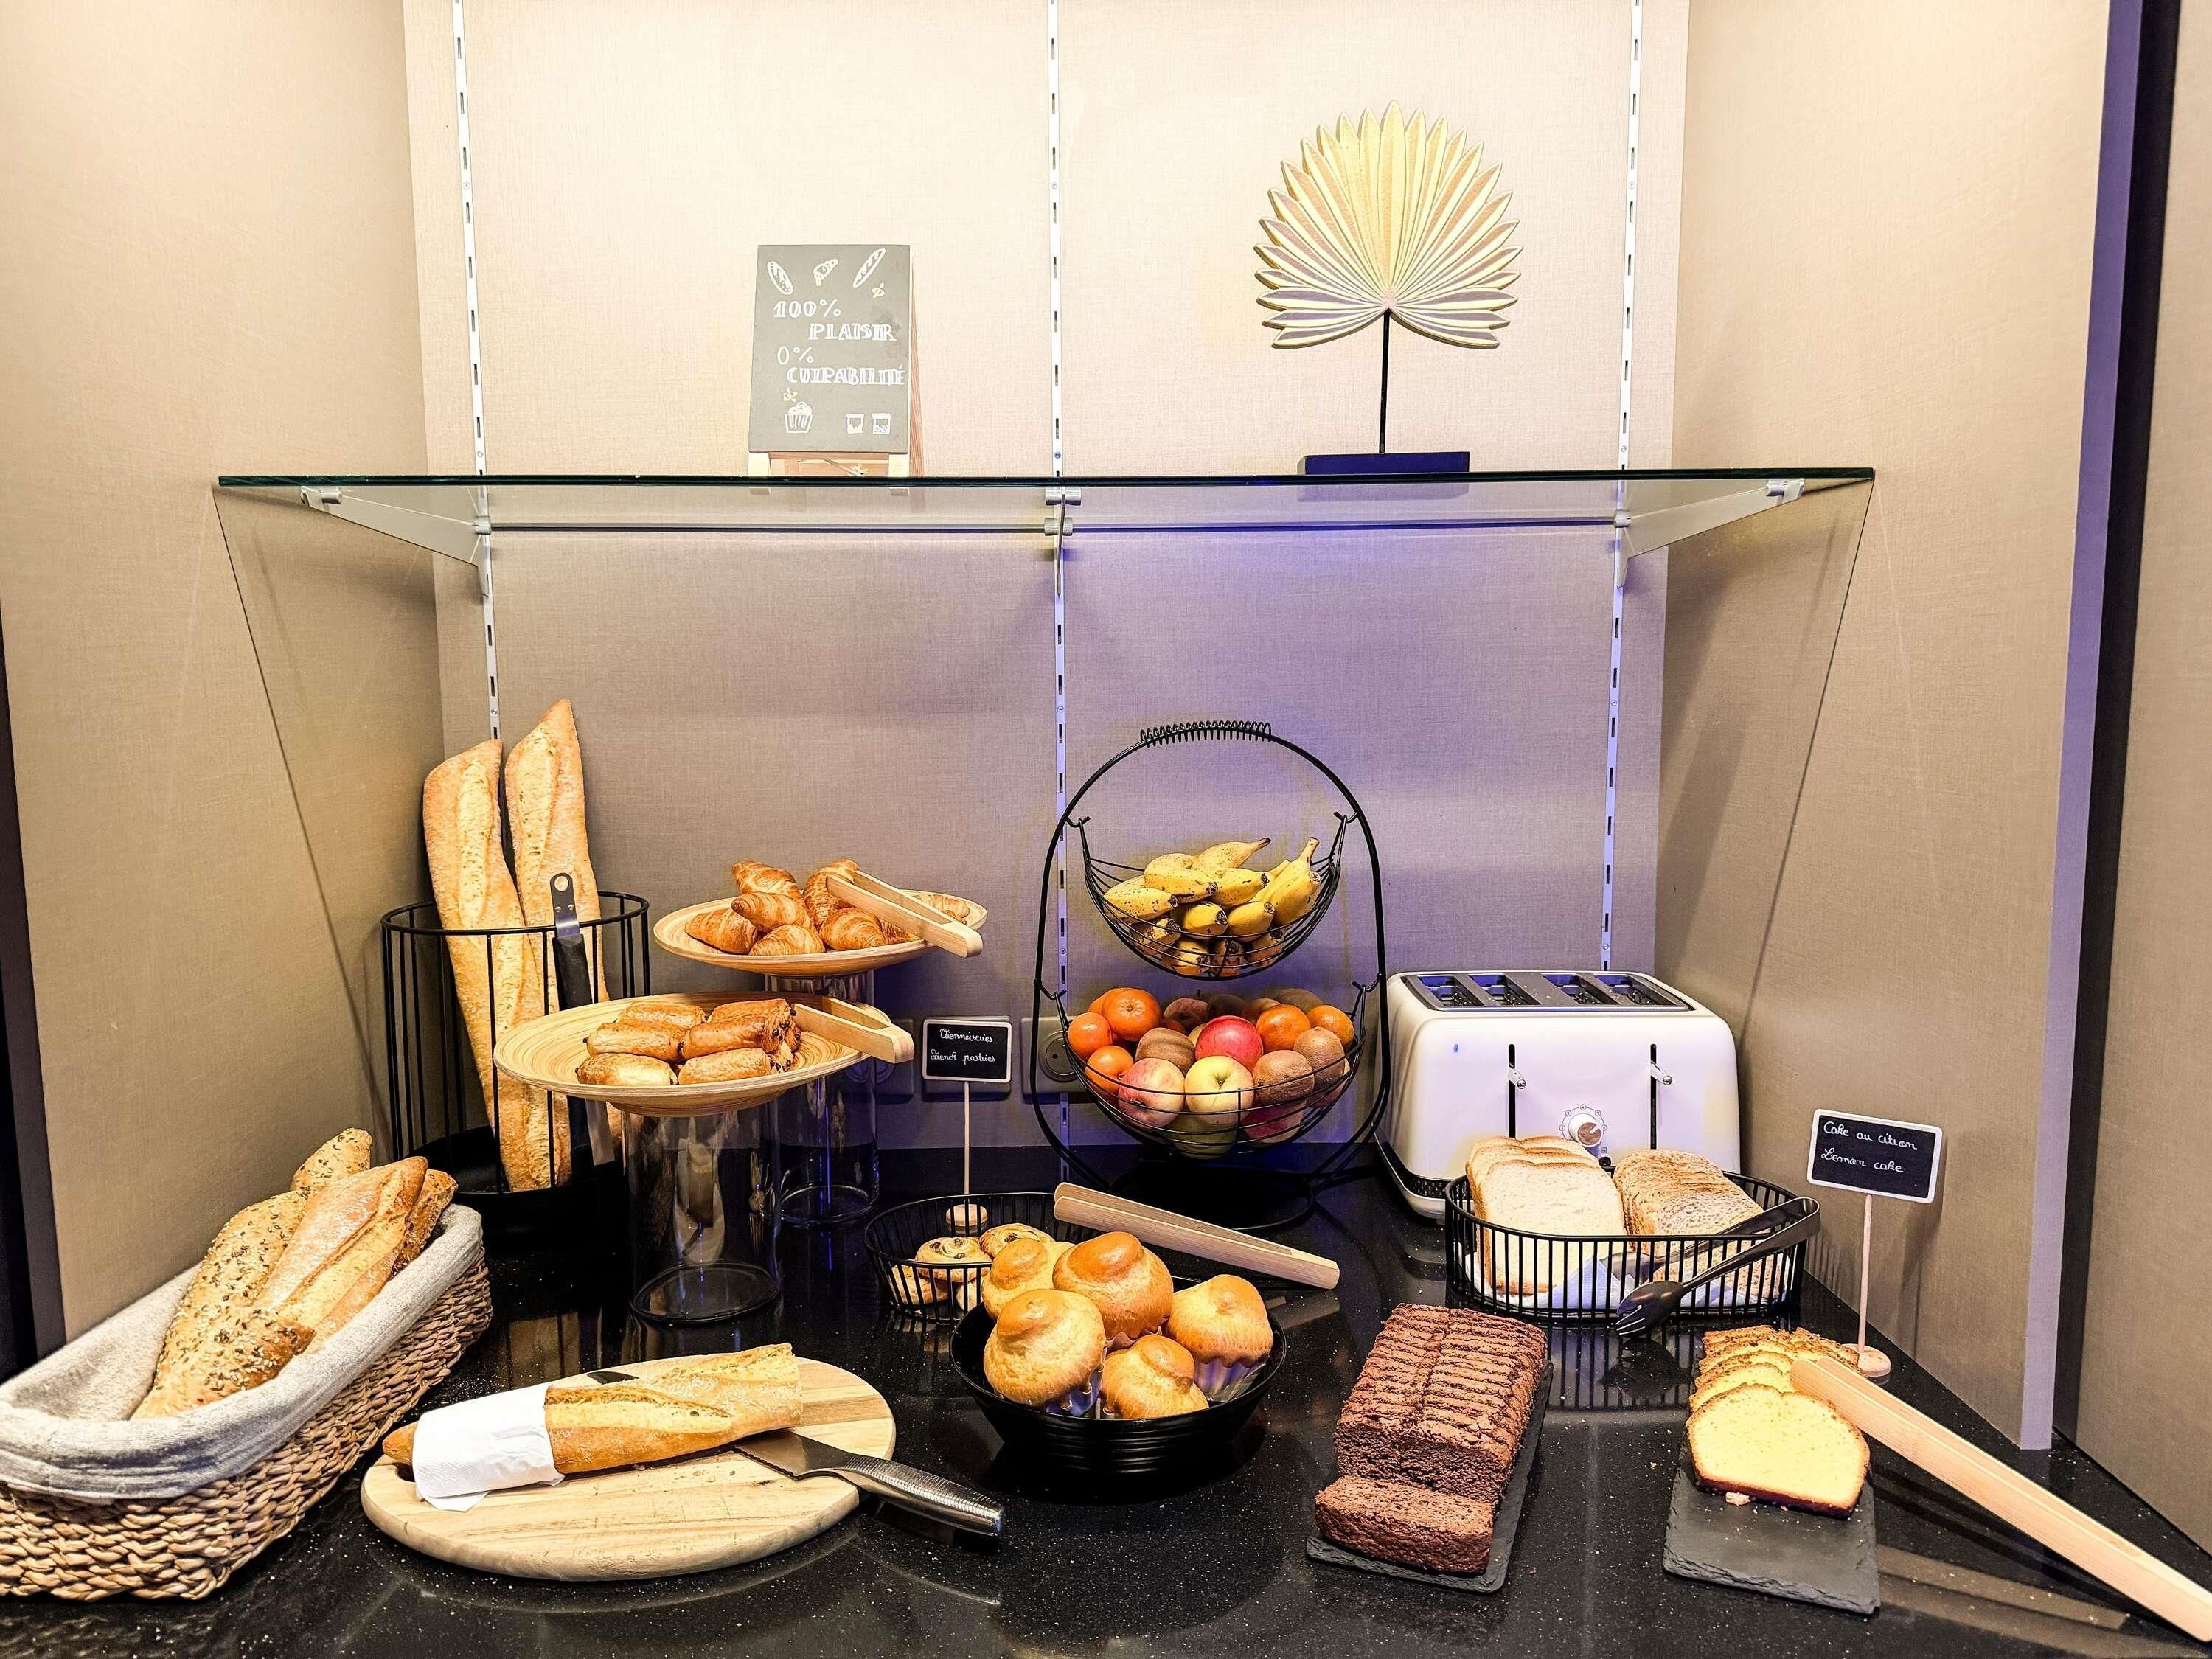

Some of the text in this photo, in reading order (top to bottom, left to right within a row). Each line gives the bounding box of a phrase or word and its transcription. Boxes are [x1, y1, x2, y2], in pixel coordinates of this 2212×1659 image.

[773, 298, 841, 318] 100%
[808, 323, 897, 341] PLAISIR
[777, 346, 814, 365] 0%
[1823, 1121, 1918, 1150] Cake au citron
[1820, 1147, 1904, 1173] Lemon cake
